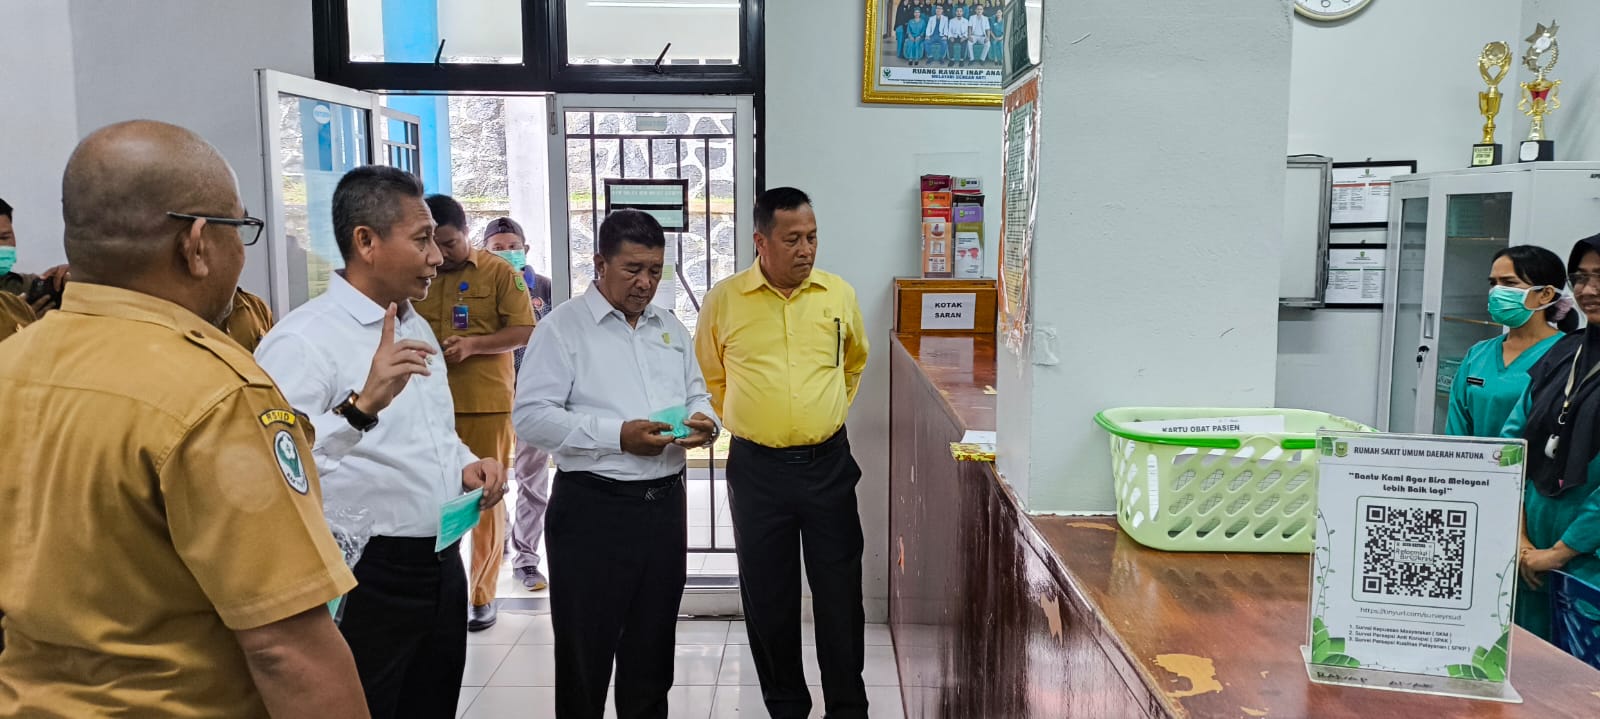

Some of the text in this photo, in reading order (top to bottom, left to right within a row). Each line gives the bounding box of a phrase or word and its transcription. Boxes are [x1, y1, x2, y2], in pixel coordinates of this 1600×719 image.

[1212, 424, 1240, 432] PASIEN
[1354, 446, 1484, 460] RUMAH SAKIT UMUM DAERAH NATUNA
[1381, 474, 1404, 482] Kami
[1406, 475, 1426, 484] Agar
[1428, 476, 1446, 484] Bisa
[1448, 477, 1490, 488] Melayani
[1407, 486, 1427, 494] Baik
